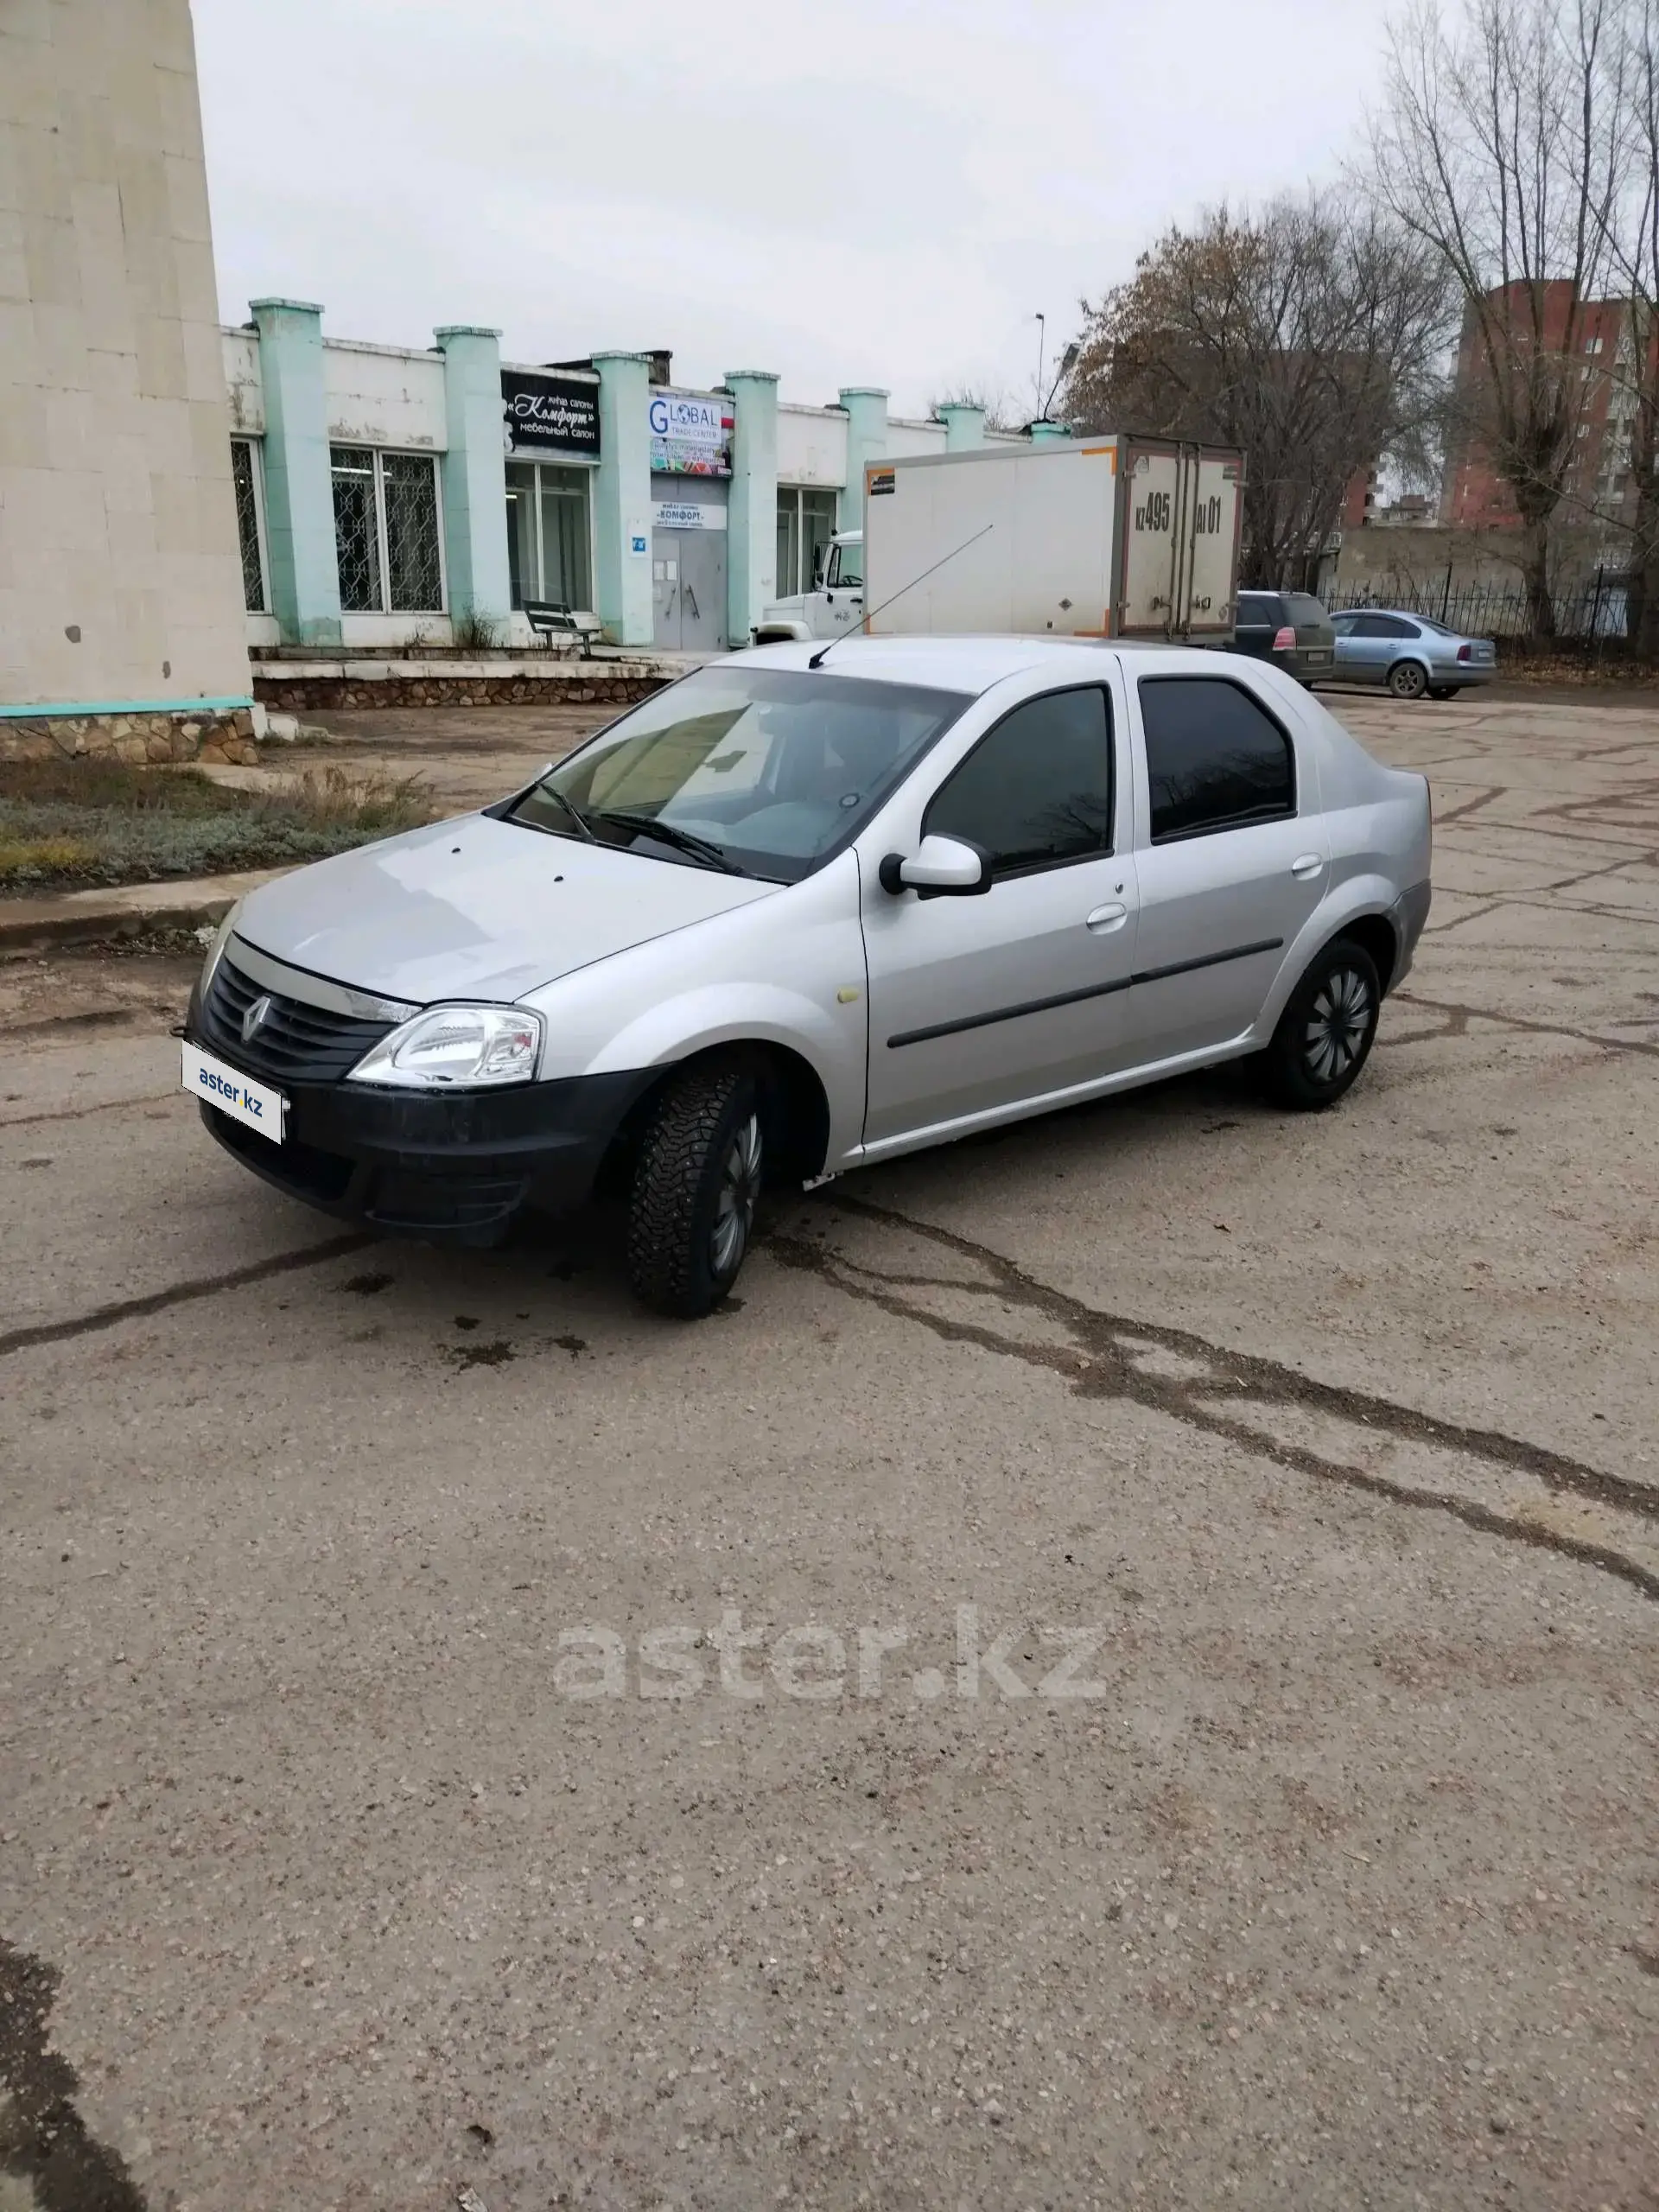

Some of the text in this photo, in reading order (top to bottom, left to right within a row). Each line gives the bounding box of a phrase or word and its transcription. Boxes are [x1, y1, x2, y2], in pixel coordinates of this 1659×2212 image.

[570, 399, 594, 410] салоны
[650, 400, 718, 434] GLOBAL
[520, 423, 594, 439] мебельный салон
[672, 427, 717, 439] TRADE CENTER
